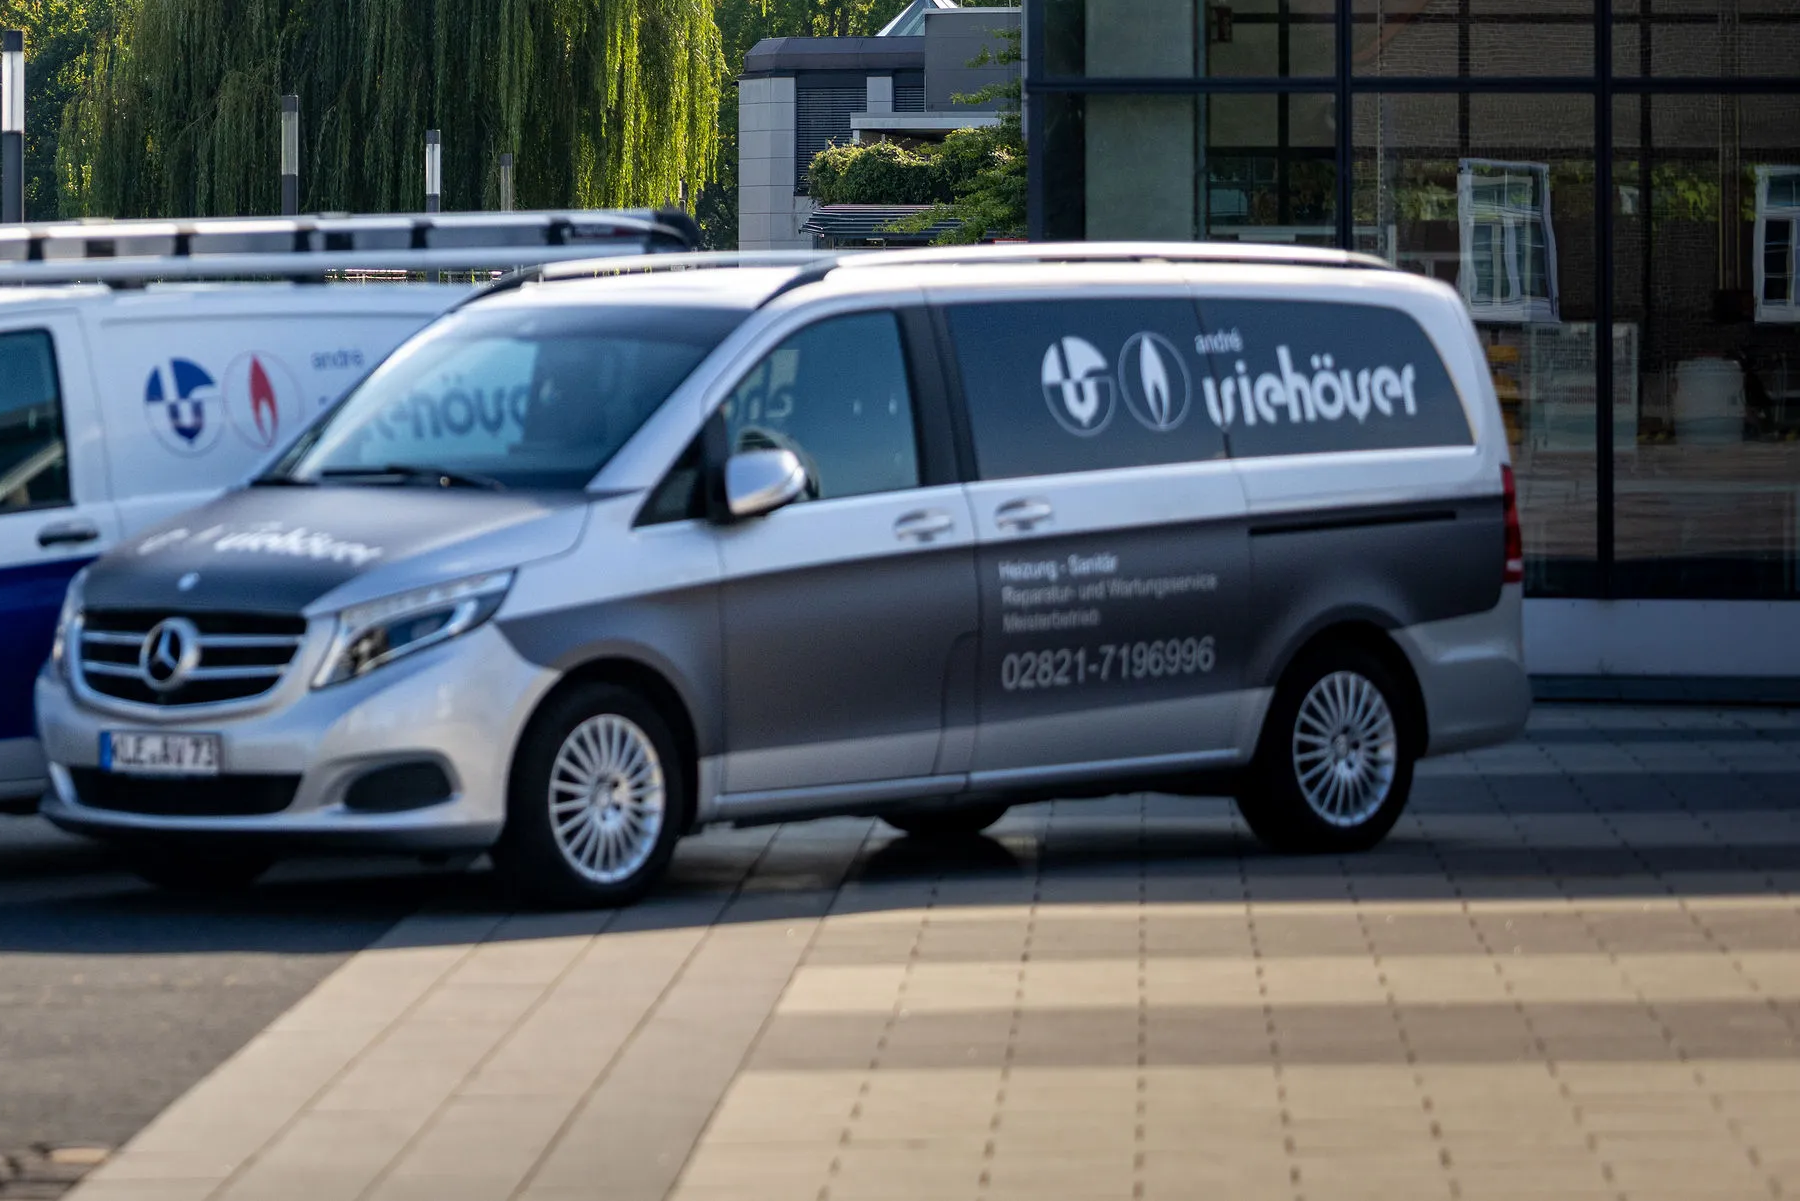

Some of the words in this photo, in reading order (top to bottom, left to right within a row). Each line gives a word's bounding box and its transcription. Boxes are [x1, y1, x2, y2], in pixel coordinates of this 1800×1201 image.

[1195, 328, 1243, 353] andré
[1202, 345, 1417, 431] viehöver
[999, 560, 1058, 582] Heizung
[1001, 635, 1216, 691] 02821-7196996
